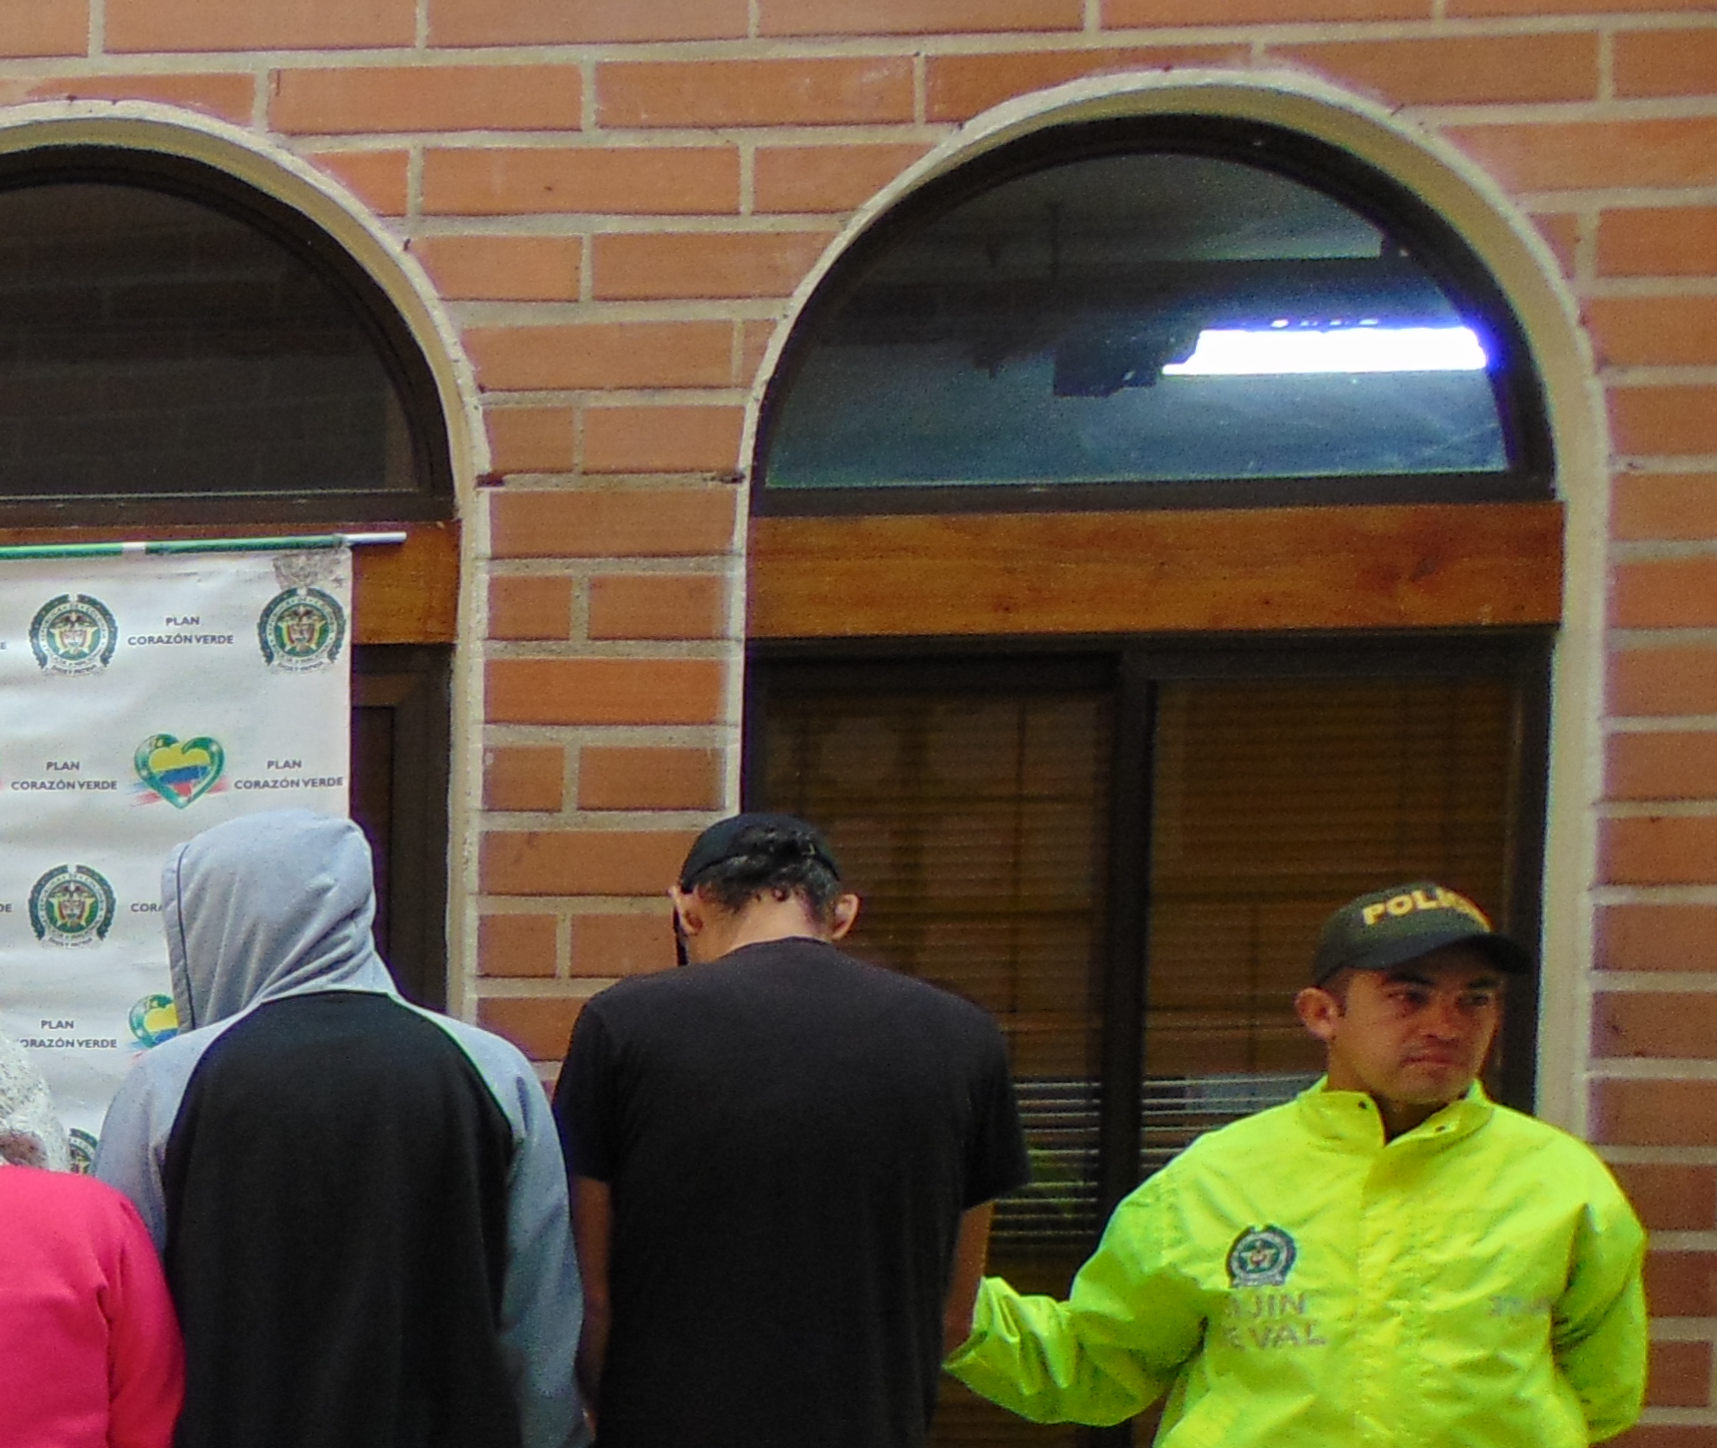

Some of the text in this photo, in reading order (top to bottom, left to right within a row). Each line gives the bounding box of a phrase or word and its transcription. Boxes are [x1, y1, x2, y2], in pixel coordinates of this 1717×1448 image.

[165, 615, 201, 626] PLAN
[127, 632, 234, 646] CORAZÓN VERDE
[45, 761, 80, 771] PLAN
[266, 759, 302, 770] PLAN
[10, 777, 118, 791] CORAZÓN VERDE
[233, 776, 343, 790] CORAZÓN VERDE
[40, 1019, 75, 1030] PLAN
[76, 1038, 117, 1049] VERDE
